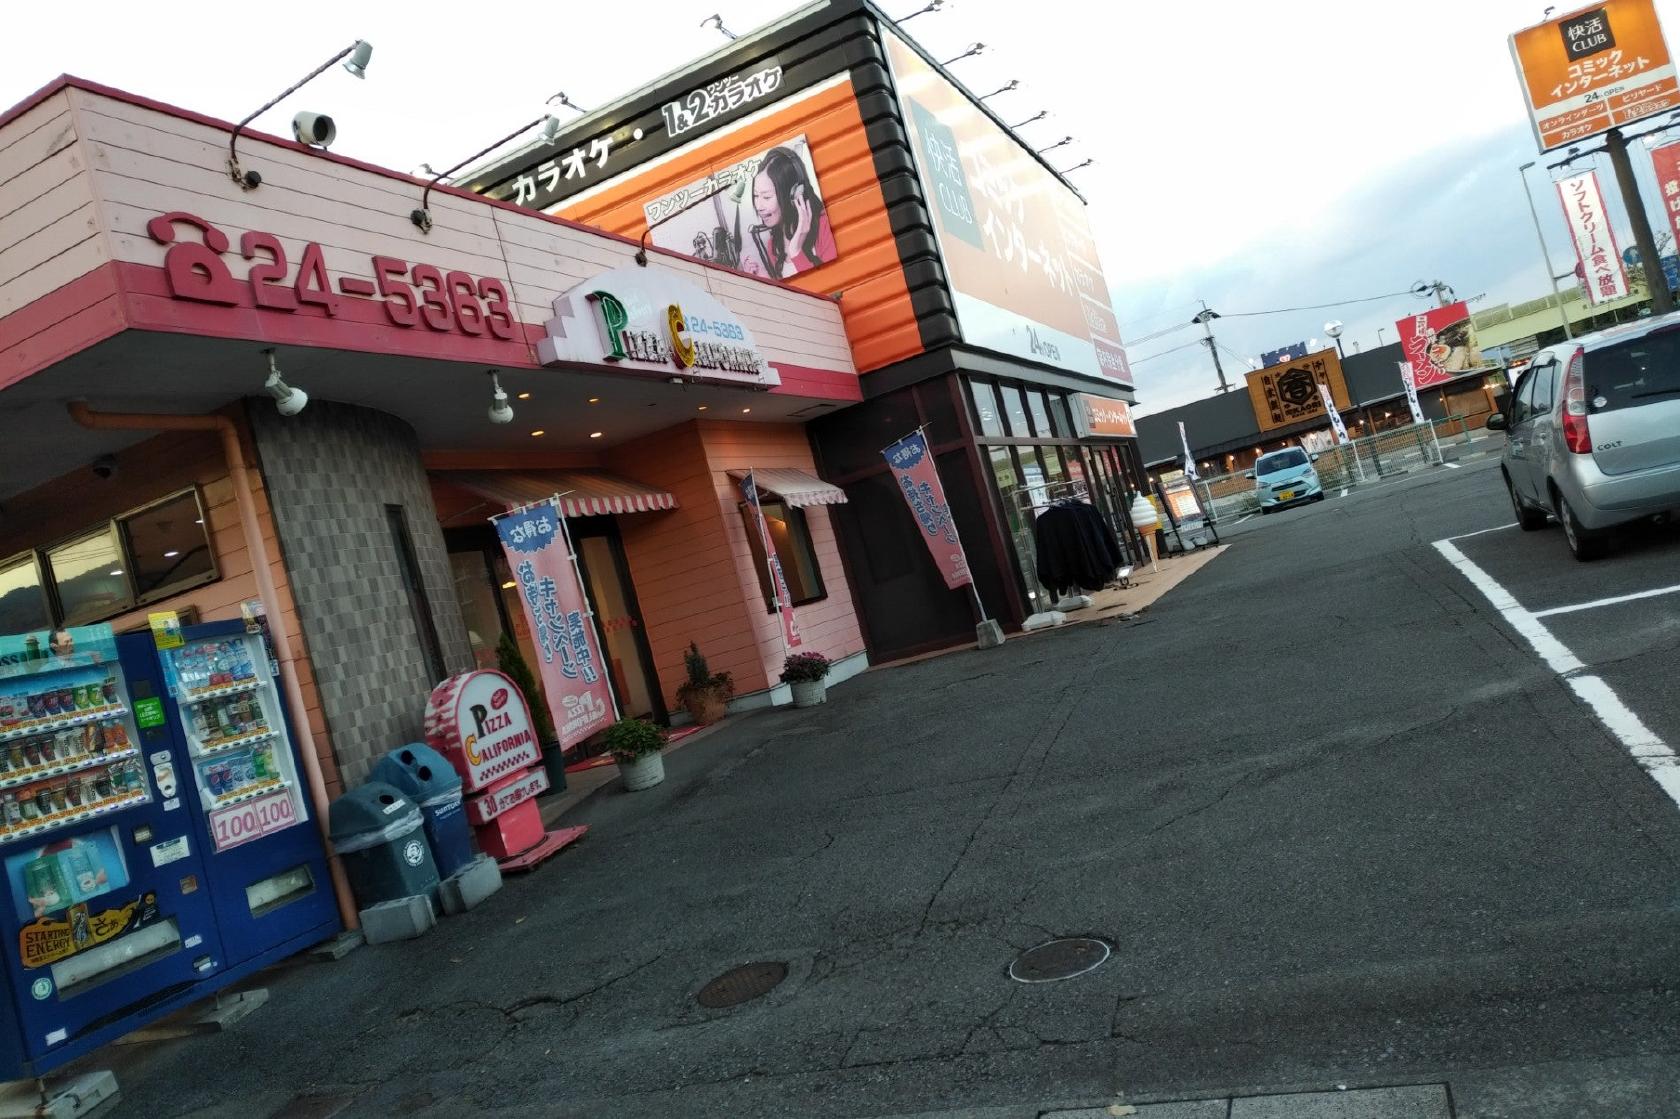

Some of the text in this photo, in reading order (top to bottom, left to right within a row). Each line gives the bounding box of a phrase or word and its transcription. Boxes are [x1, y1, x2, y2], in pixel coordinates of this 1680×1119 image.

[1567, 17, 1603, 41] 快活
[1572, 33, 1607, 53] CLUB
[1550, 56, 1650, 98] インターネット
[1567, 49, 1624, 80] コミック
[707, 75, 739, 95] ワンツー
[1561, 123, 1593, 141] カラオケ
[924, 127, 962, 187] 快活
[645, 159, 761, 221] ワンツーカラオケ
[938, 183, 973, 226] CLUB
[1570, 180, 1618, 297] ソフトクリーム食べ放題
[240, 230, 515, 341] 24-5363
[1597, 440, 1622, 451] COLT
[469, 703, 513, 738] PIZZA
[464, 729, 533, 767] CALIFORNIA
[218, 797, 291, 842] 100 100
[25, 926, 71, 944] STARTING
[25, 937, 71, 959] ENERGY
